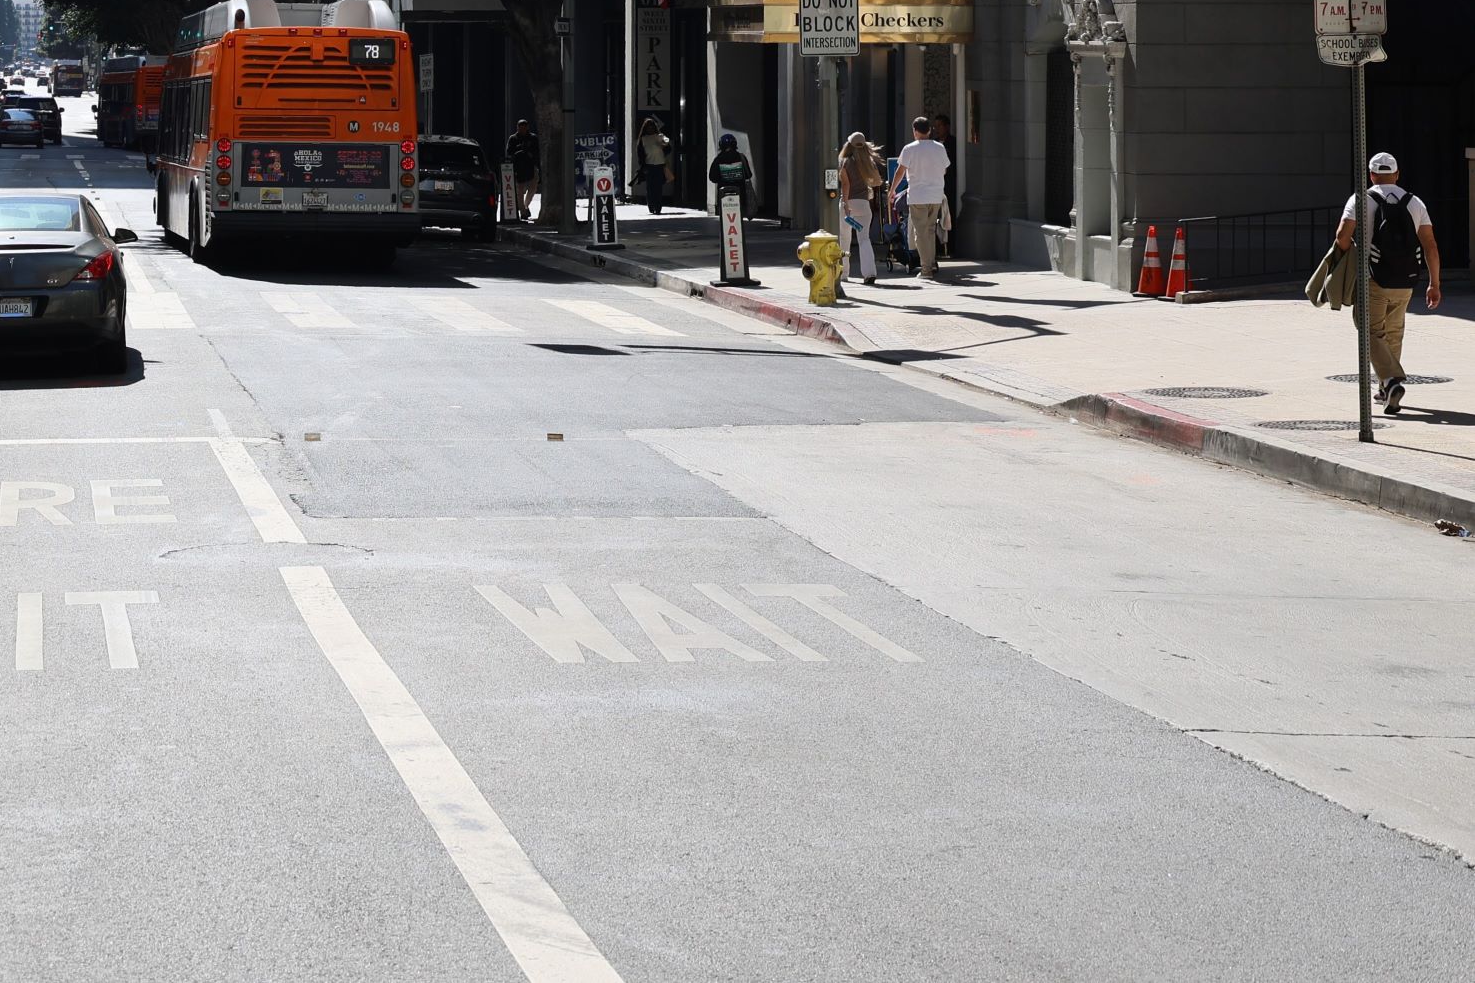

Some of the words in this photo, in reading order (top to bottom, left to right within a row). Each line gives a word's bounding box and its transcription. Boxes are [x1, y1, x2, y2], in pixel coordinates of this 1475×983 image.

[1320, 3, 1328, 16] 7
[1362, 2, 1368, 15] 7
[803, 16, 856, 32] BLOCK
[861, 13, 944, 27] Checkers
[803, 37, 856, 49] INTERSECTION
[1321, 39, 1355, 48] SCHOOL
[1358, 38, 1378, 48] BUSES
[364, 45, 379, 59] 78
[646, 37, 662, 106] PARK
[372, 121, 399, 133] 1948
[575, 136, 614, 147] PUBLIC
[600, 181, 608, 191] V
[505, 175, 514, 215] VALET
[601, 196, 609, 241] VALET
[726, 213, 740, 272] VALET
[473, 583, 926, 663] WAIT
